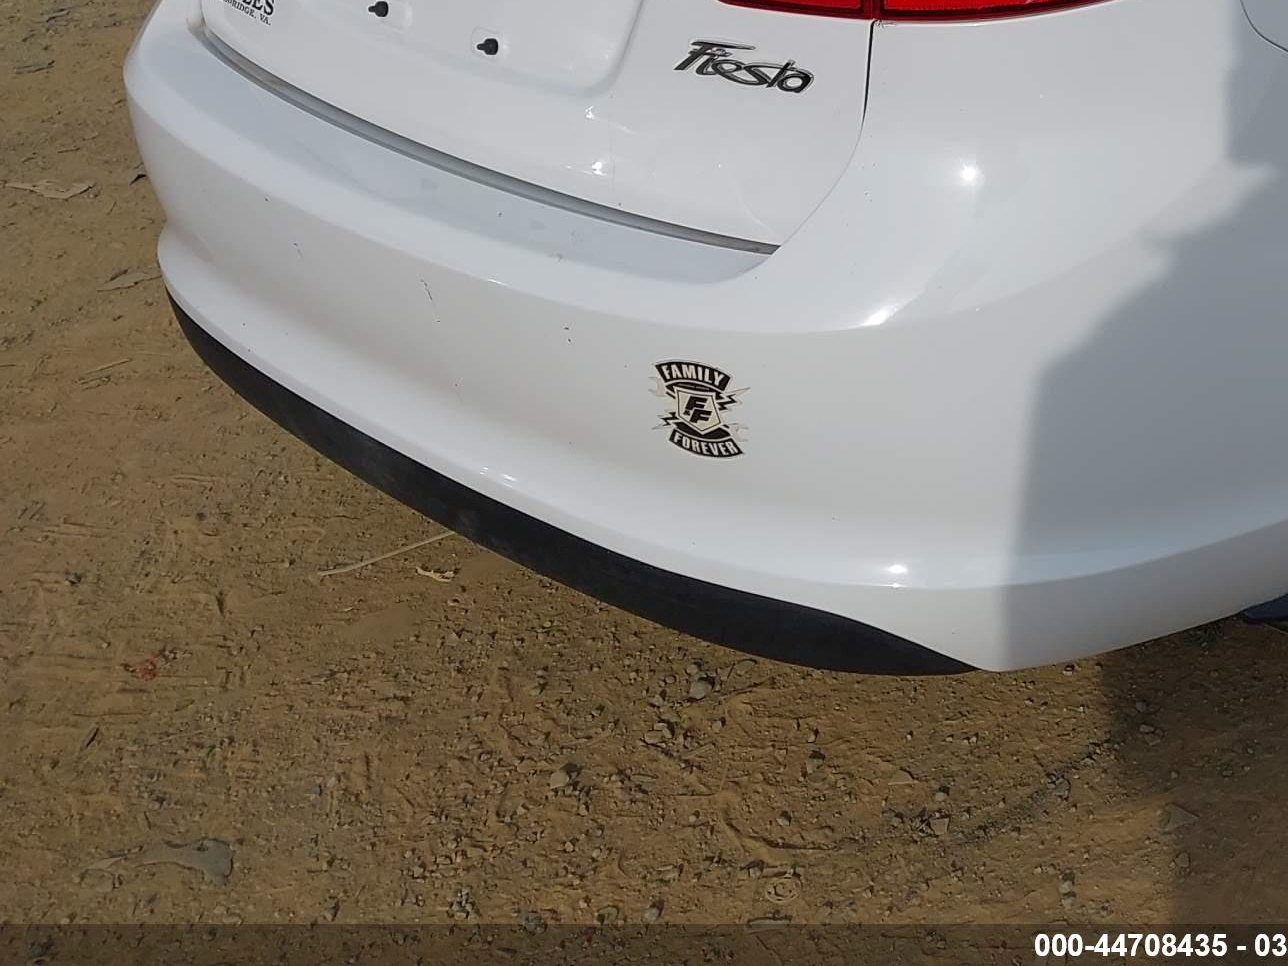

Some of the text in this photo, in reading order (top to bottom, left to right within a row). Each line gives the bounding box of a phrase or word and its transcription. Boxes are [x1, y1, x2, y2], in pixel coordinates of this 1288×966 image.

[260, 13, 271, 26] VA.
[673, 41, 815, 93] Fiesta
[660, 363, 725, 387] FAMILY
[673, 432, 739, 456] FOREVER
